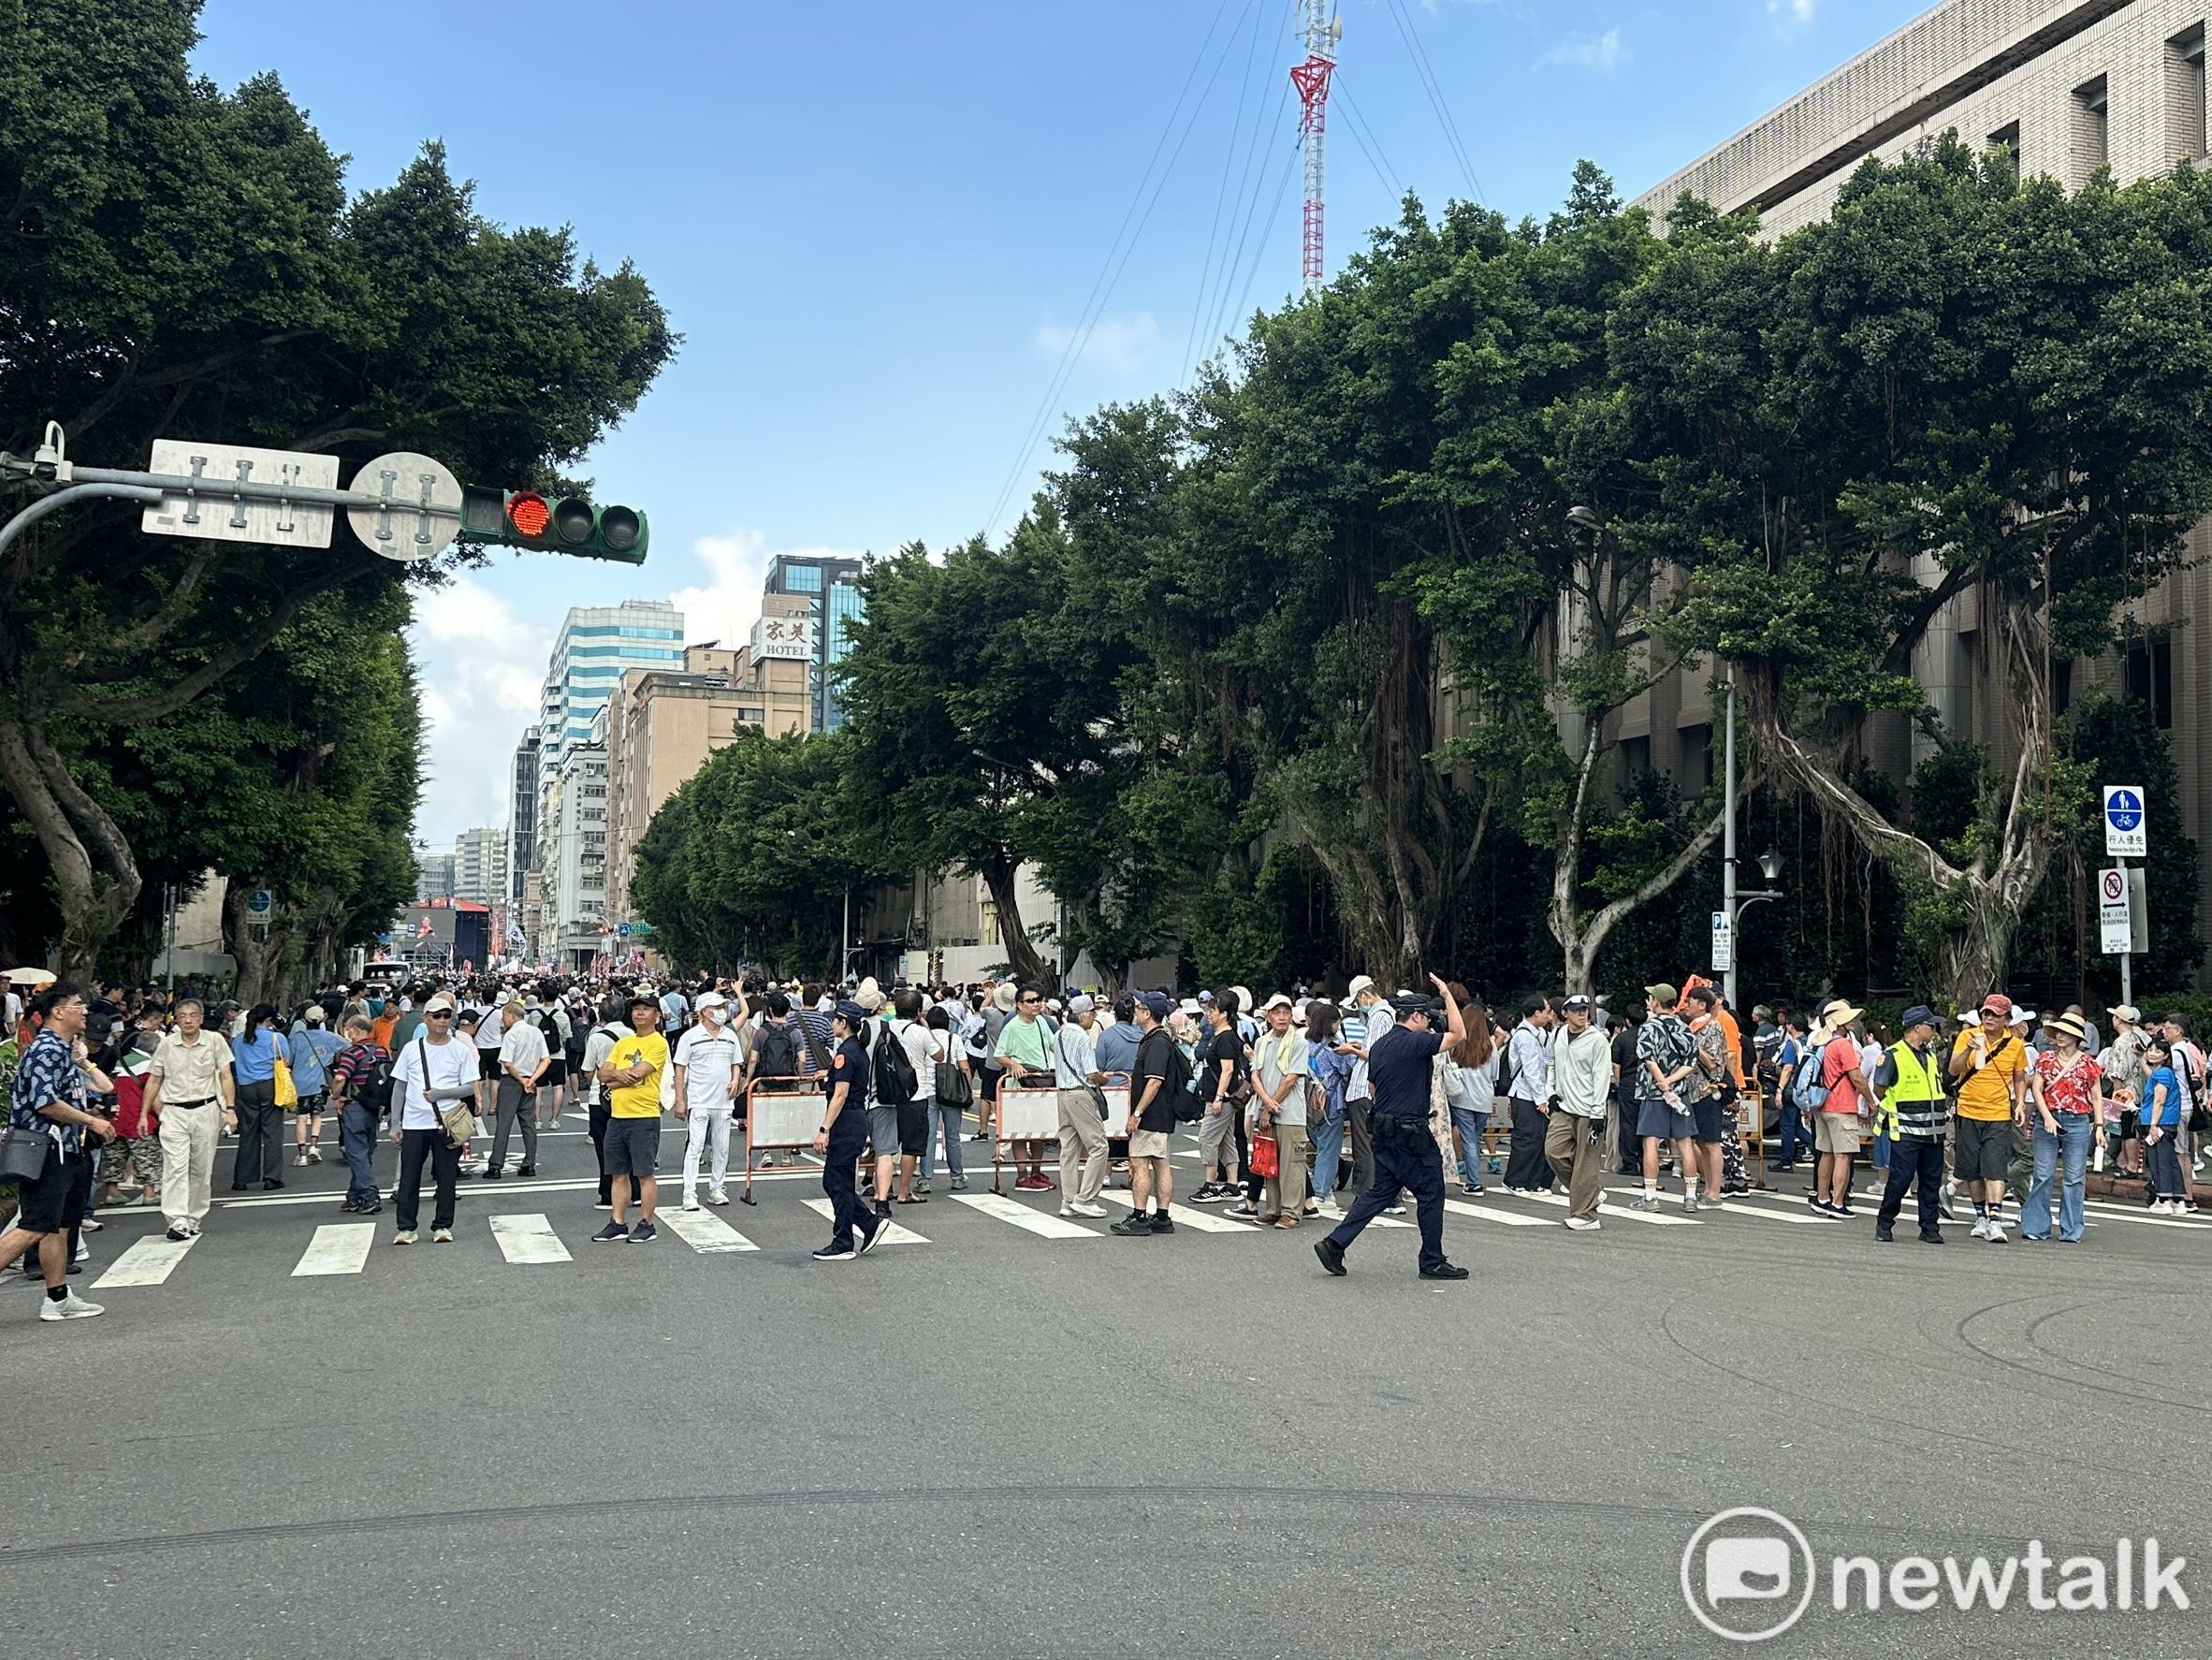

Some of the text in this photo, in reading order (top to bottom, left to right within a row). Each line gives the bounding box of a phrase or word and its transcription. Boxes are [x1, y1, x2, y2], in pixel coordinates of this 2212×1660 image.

[767, 645, 808, 656] HOTEL
[2108, 835, 2144, 846] 行人優先
